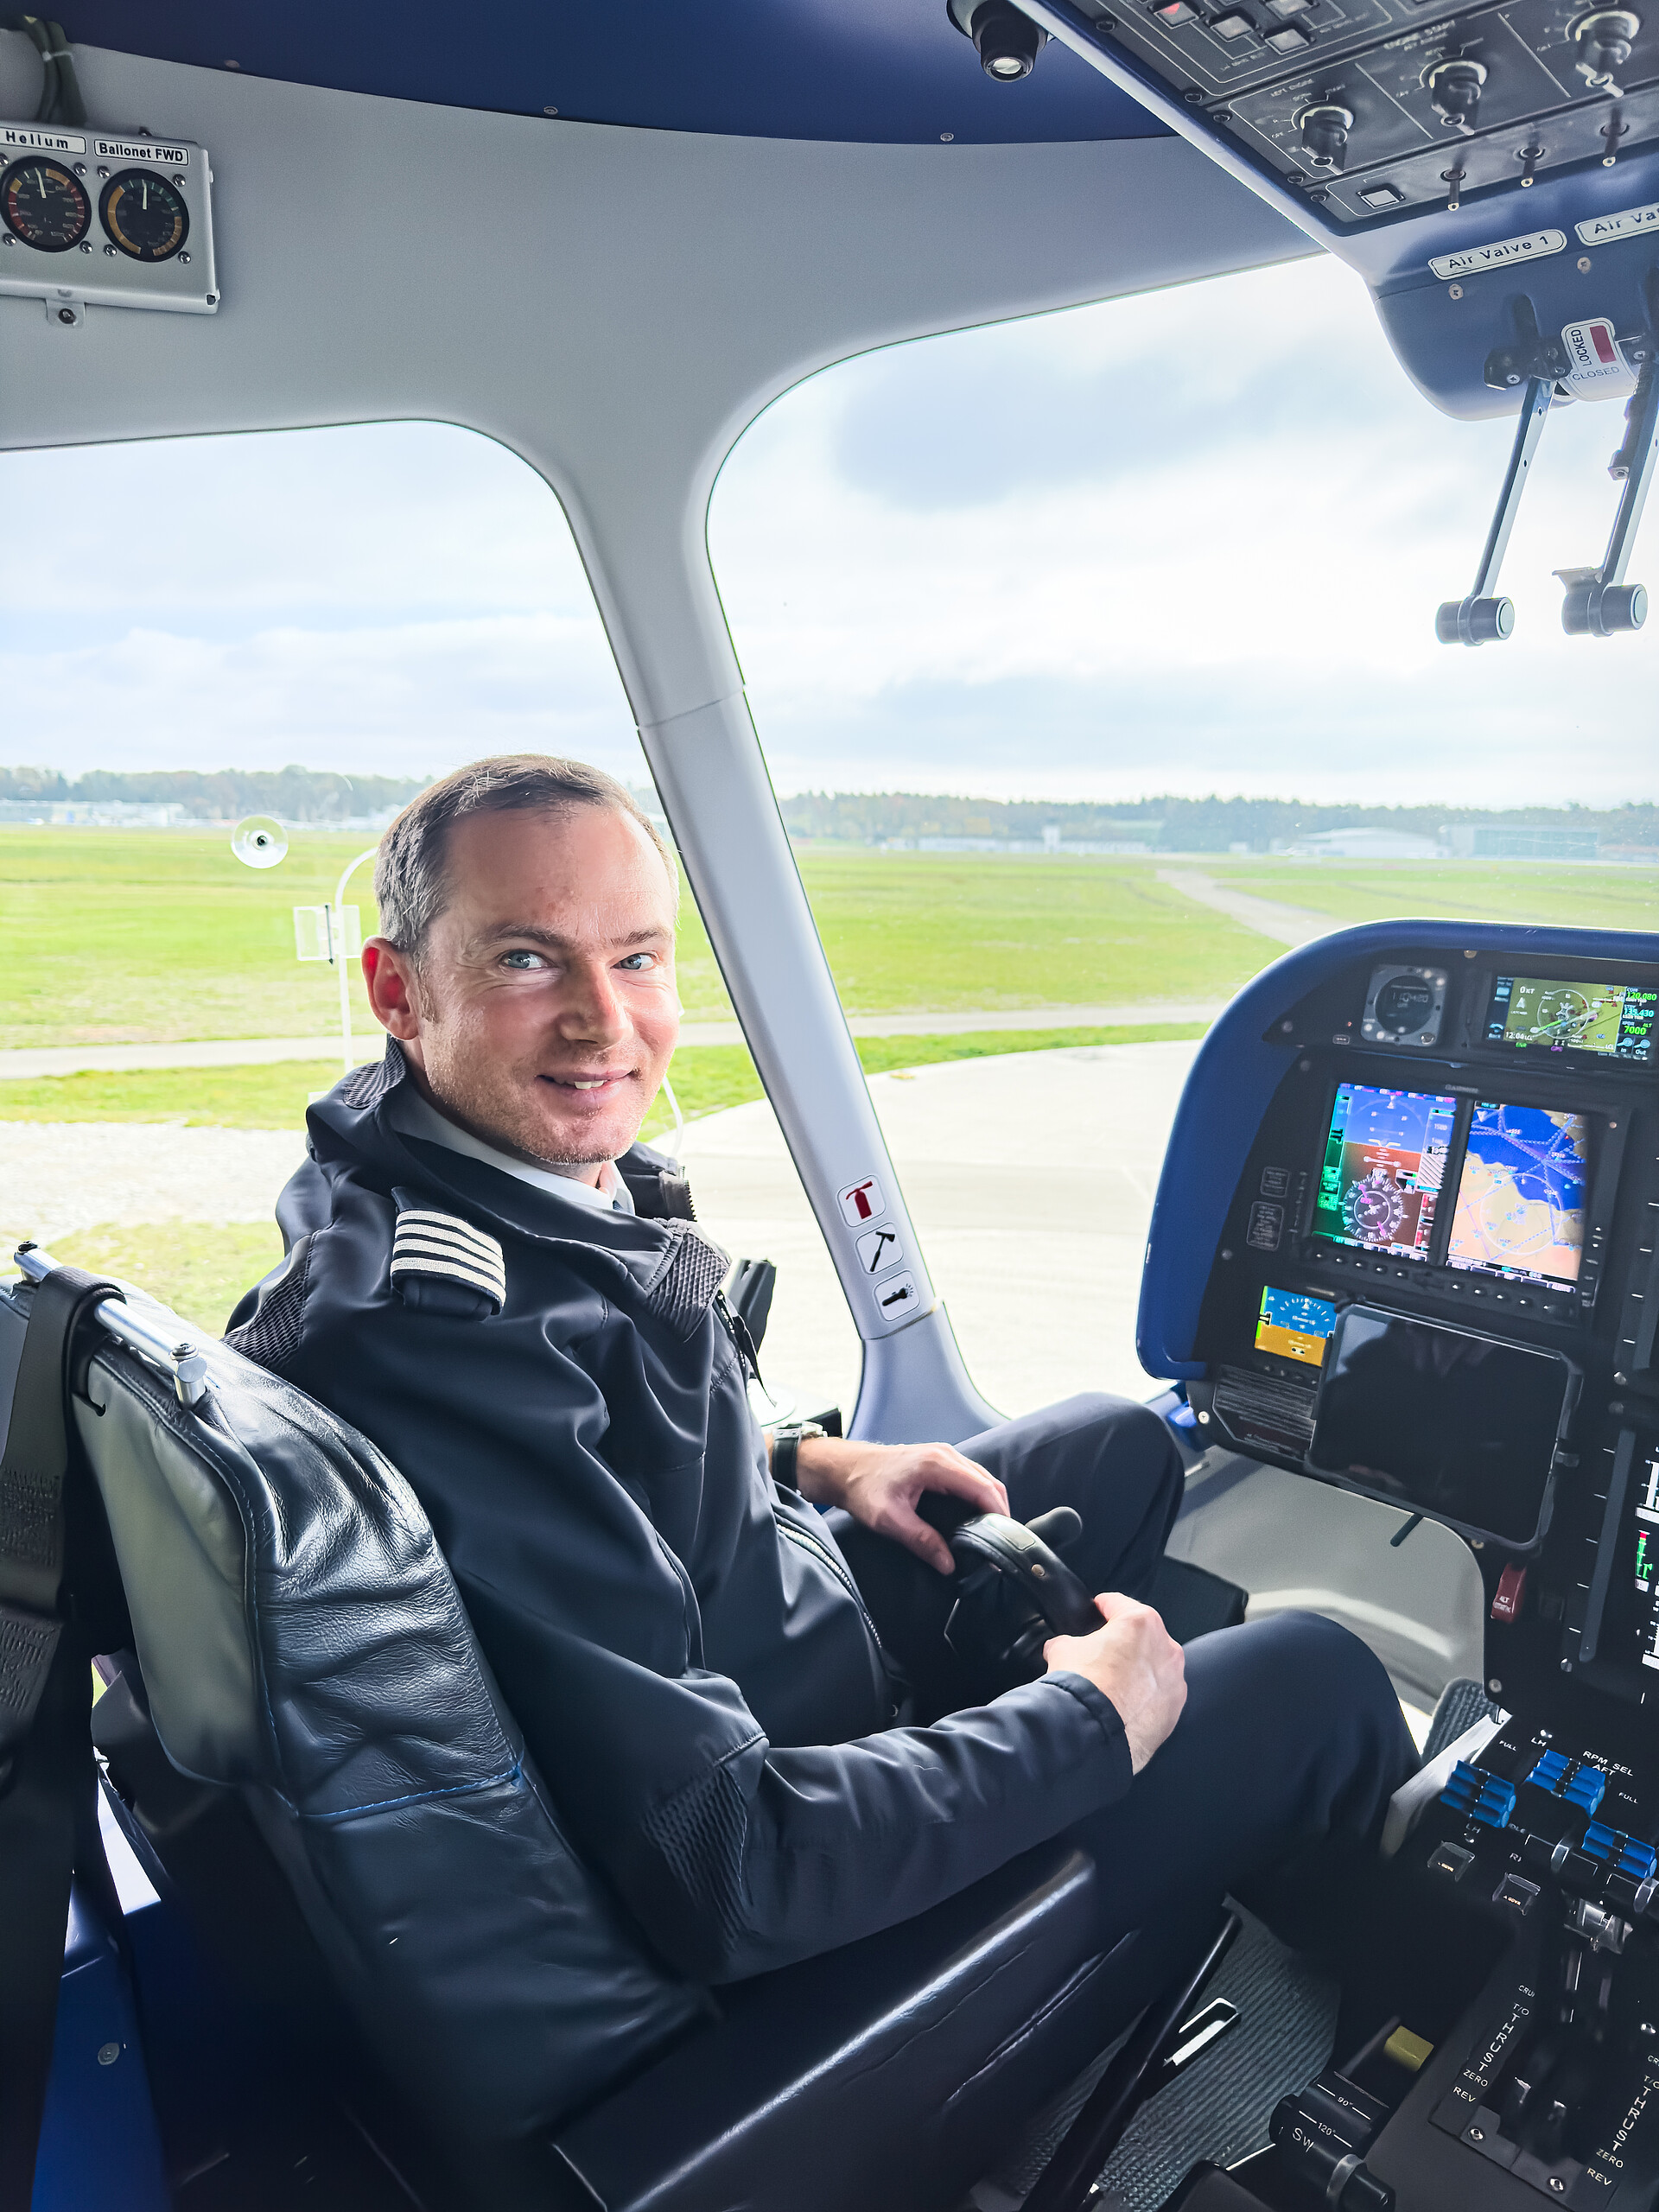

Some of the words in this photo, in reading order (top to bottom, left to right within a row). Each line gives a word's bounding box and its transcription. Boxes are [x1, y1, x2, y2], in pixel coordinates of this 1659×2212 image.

[5, 130, 68, 149] Helium
[99, 142, 151, 159] Ballonet
[156, 148, 183, 162] FWD
[1595, 219, 1622, 234] Air
[1630, 204, 1659, 223] Va
[1449, 256, 1473, 270] Air
[1478, 240, 1533, 260] Valve
[1539, 235, 1549, 246] 1
[1571, 329, 1592, 367] LOCKED
[1572, 366, 1620, 381] CLOSED
[1627, 991, 1658, 1001] 120.080
[1624, 1007, 1655, 1018] 135.430
[1624, 1025, 1647, 1036] 7000
[1498, 1740, 1517, 1751] FULL
[1531, 1737, 1547, 1747] LH
[1582, 1751, 1609, 1765] RPM
[1612, 1763, 1634, 1777] SEL
[1592, 1764, 1616, 1777] AFT
[1618, 1791, 1639, 1804] FULL
[1465, 1823, 1481, 1834] LH
[1513, 2002, 1529, 2016] T/O
[1478, 2012, 1521, 2072] THRUST
[1647, 2055, 1659, 2067] CR
[1463, 2069, 1489, 2088] ZERO
[1452, 2086, 1477, 2103] REV
[1611, 2085, 1652, 2152] THRUST
[1596, 2148, 1624, 2169] ZERO
[1586, 2167, 1612, 2187] REV
